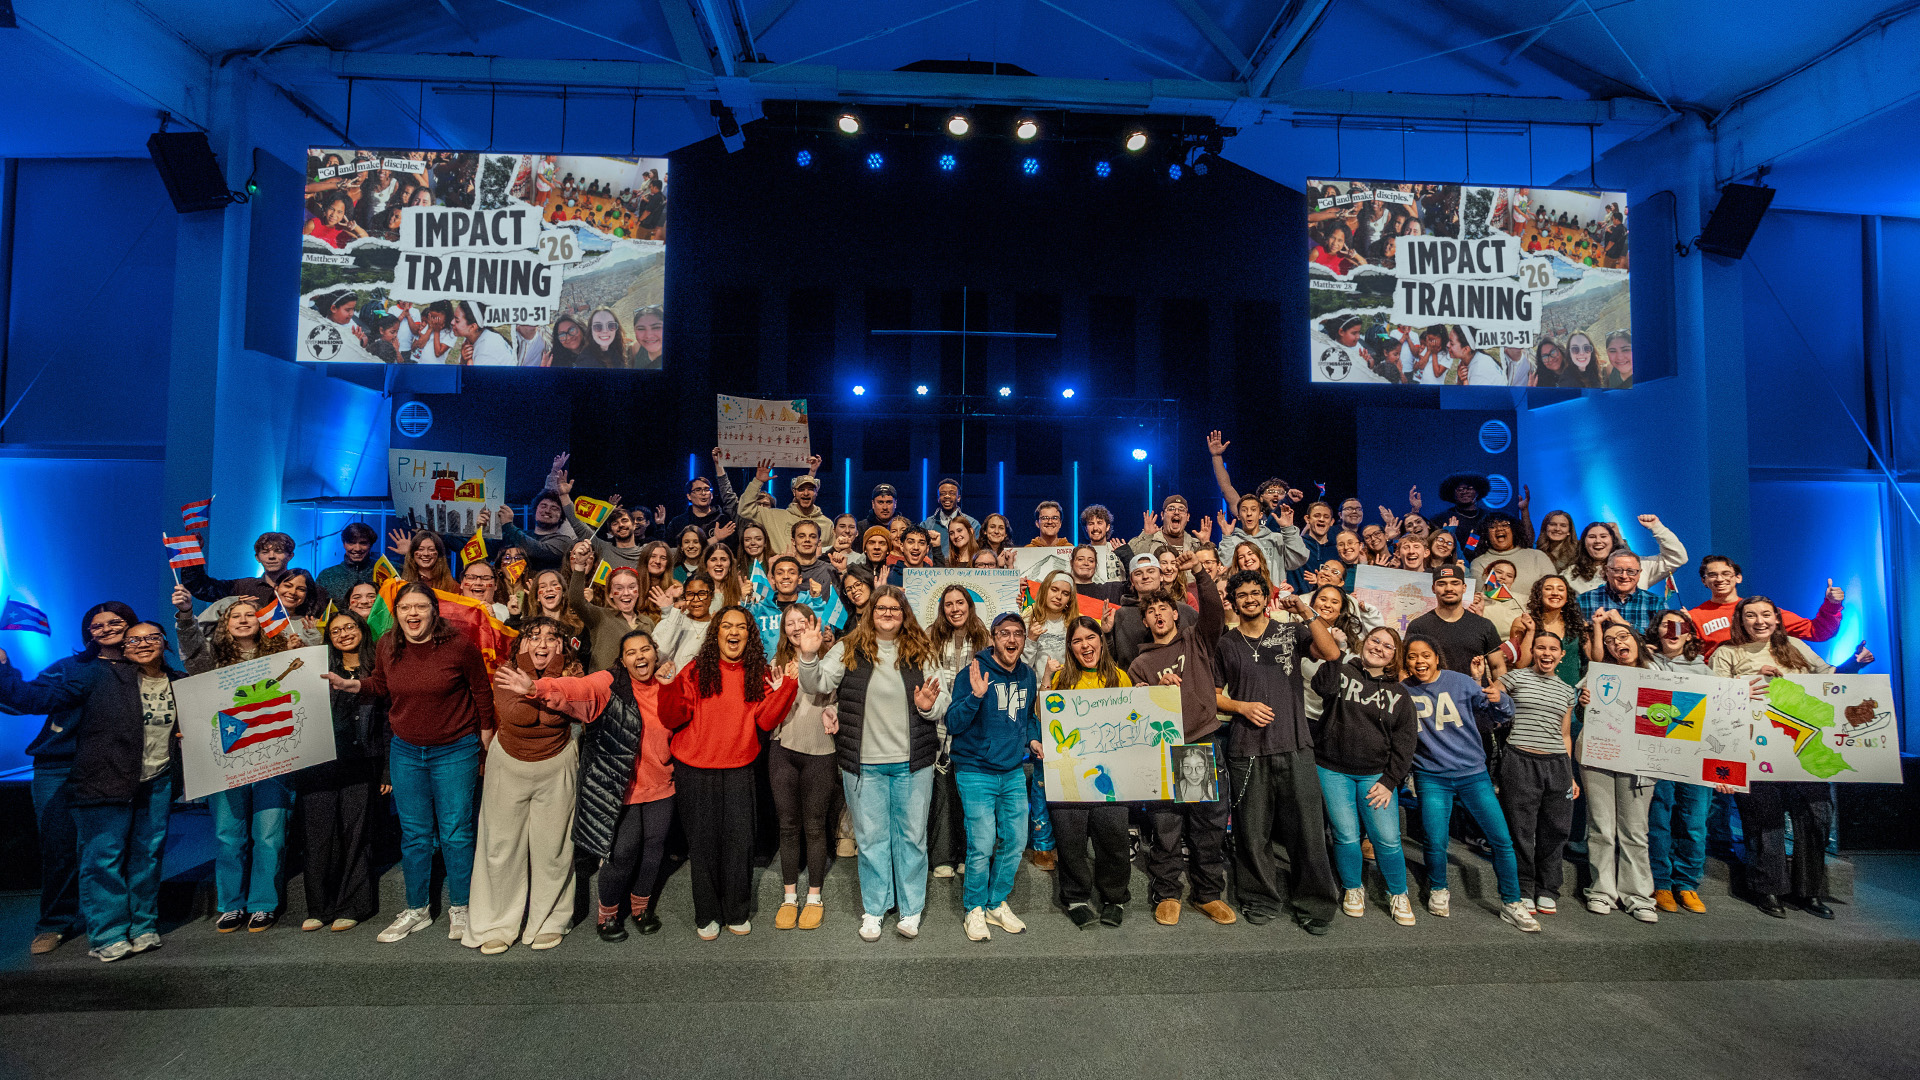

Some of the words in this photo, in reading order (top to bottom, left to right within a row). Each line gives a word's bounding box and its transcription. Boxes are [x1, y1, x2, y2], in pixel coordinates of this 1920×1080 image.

[340, 163, 354, 174] and
[358, 160, 380, 172] make
[1336, 194, 1350, 204] and
[1352, 192, 1374, 202] make
[414, 210, 526, 248] IMPACT
[306, 254, 338, 263] Matthew
[1408, 240, 1506, 274] IMPACT
[404, 255, 552, 297] TRAINING
[1312, 280, 1342, 290] Matthew
[1402, 282, 1532, 322] TRAINING
[486, 308, 510, 324] JAN
[512, 306, 547, 322] 30-31
[1478, 332, 1498, 346] JAN
[1500, 330, 1530, 346] 30-31
[398, 457, 494, 482] PHILLY
[399, 482, 427, 493] UVF
[957, 570, 972, 578] and
[906, 577, 922, 616] ONDURAS
[758, 614, 782, 632] TH
[1702, 616, 1730, 636] OHIO
[1338, 672, 1402, 714] PRAY
[1822, 682, 1848, 696] For
[1638, 739, 1682, 754] Latvia
[1834, 733, 1887, 749] Jesus!
